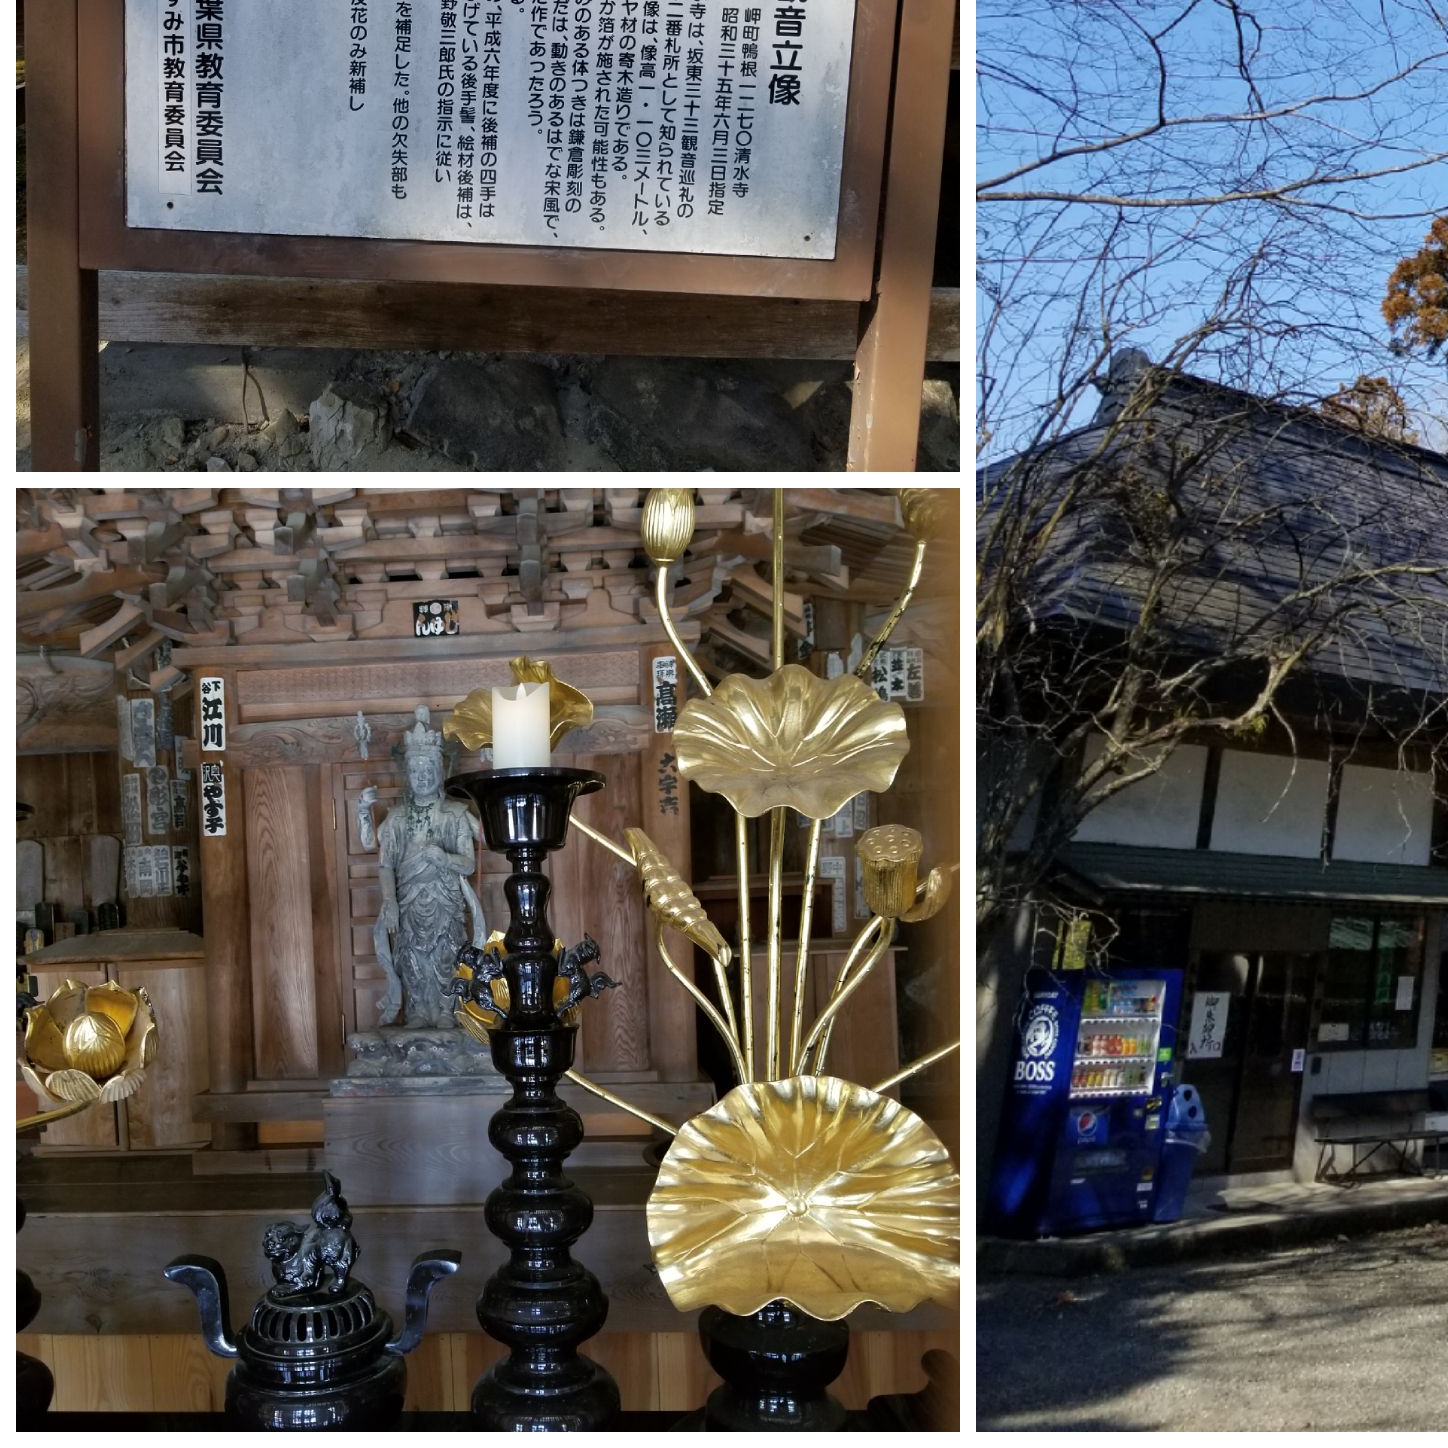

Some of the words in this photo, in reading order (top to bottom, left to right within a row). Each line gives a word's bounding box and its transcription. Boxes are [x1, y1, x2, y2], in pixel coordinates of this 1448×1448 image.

[707, 7, 740, 217] 昭和三十五年六月三日指定
[202, 696, 224, 748] 江川
[1014, 1060, 1057, 1082] BOSS
